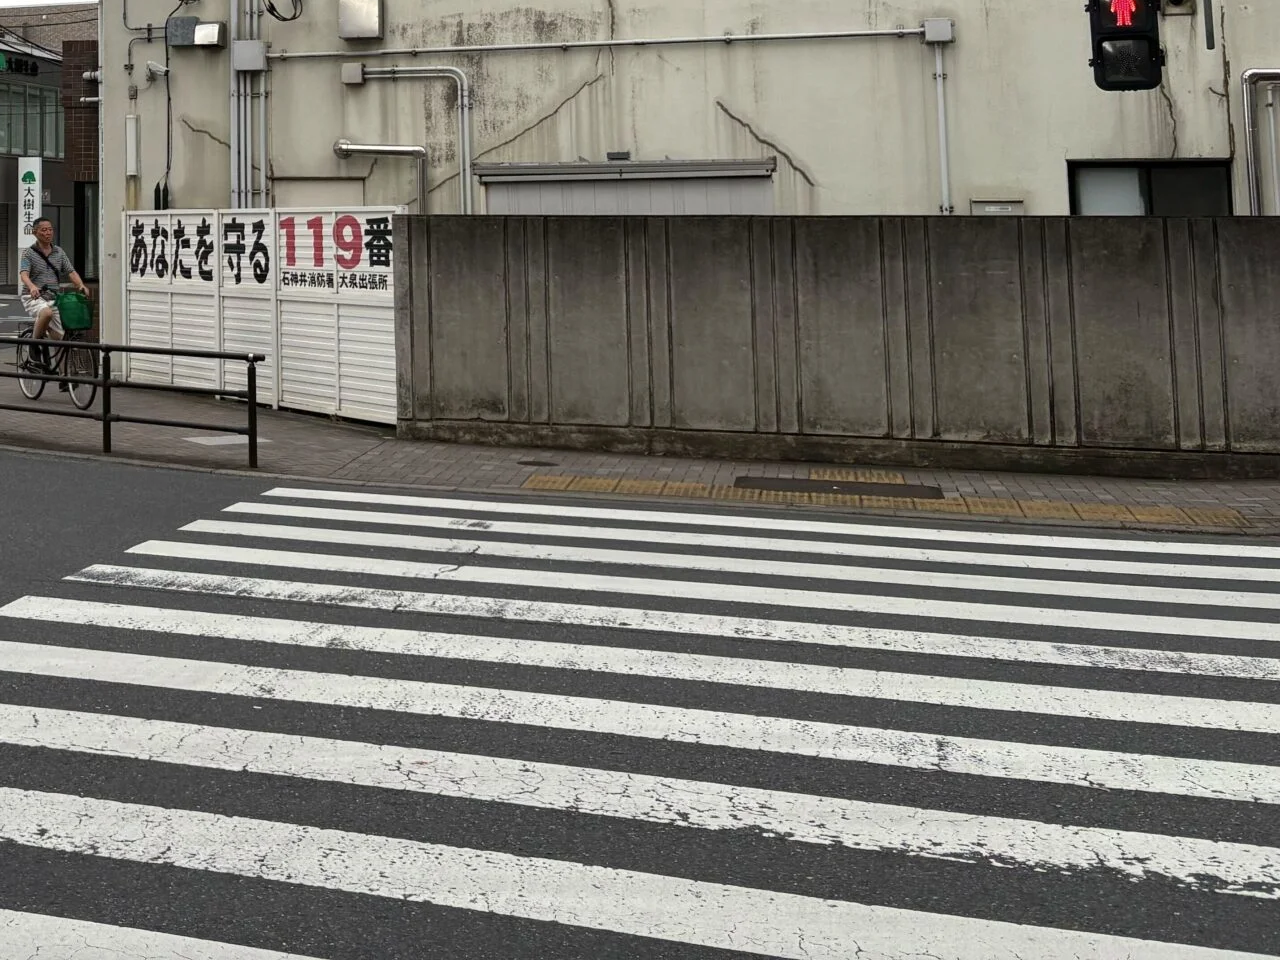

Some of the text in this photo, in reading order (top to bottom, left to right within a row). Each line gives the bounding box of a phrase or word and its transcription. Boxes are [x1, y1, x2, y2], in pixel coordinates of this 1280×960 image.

[23, 186, 35, 235] 大樹生命
[281, 271, 389, 291] 石神井消防署 大泉出張所
